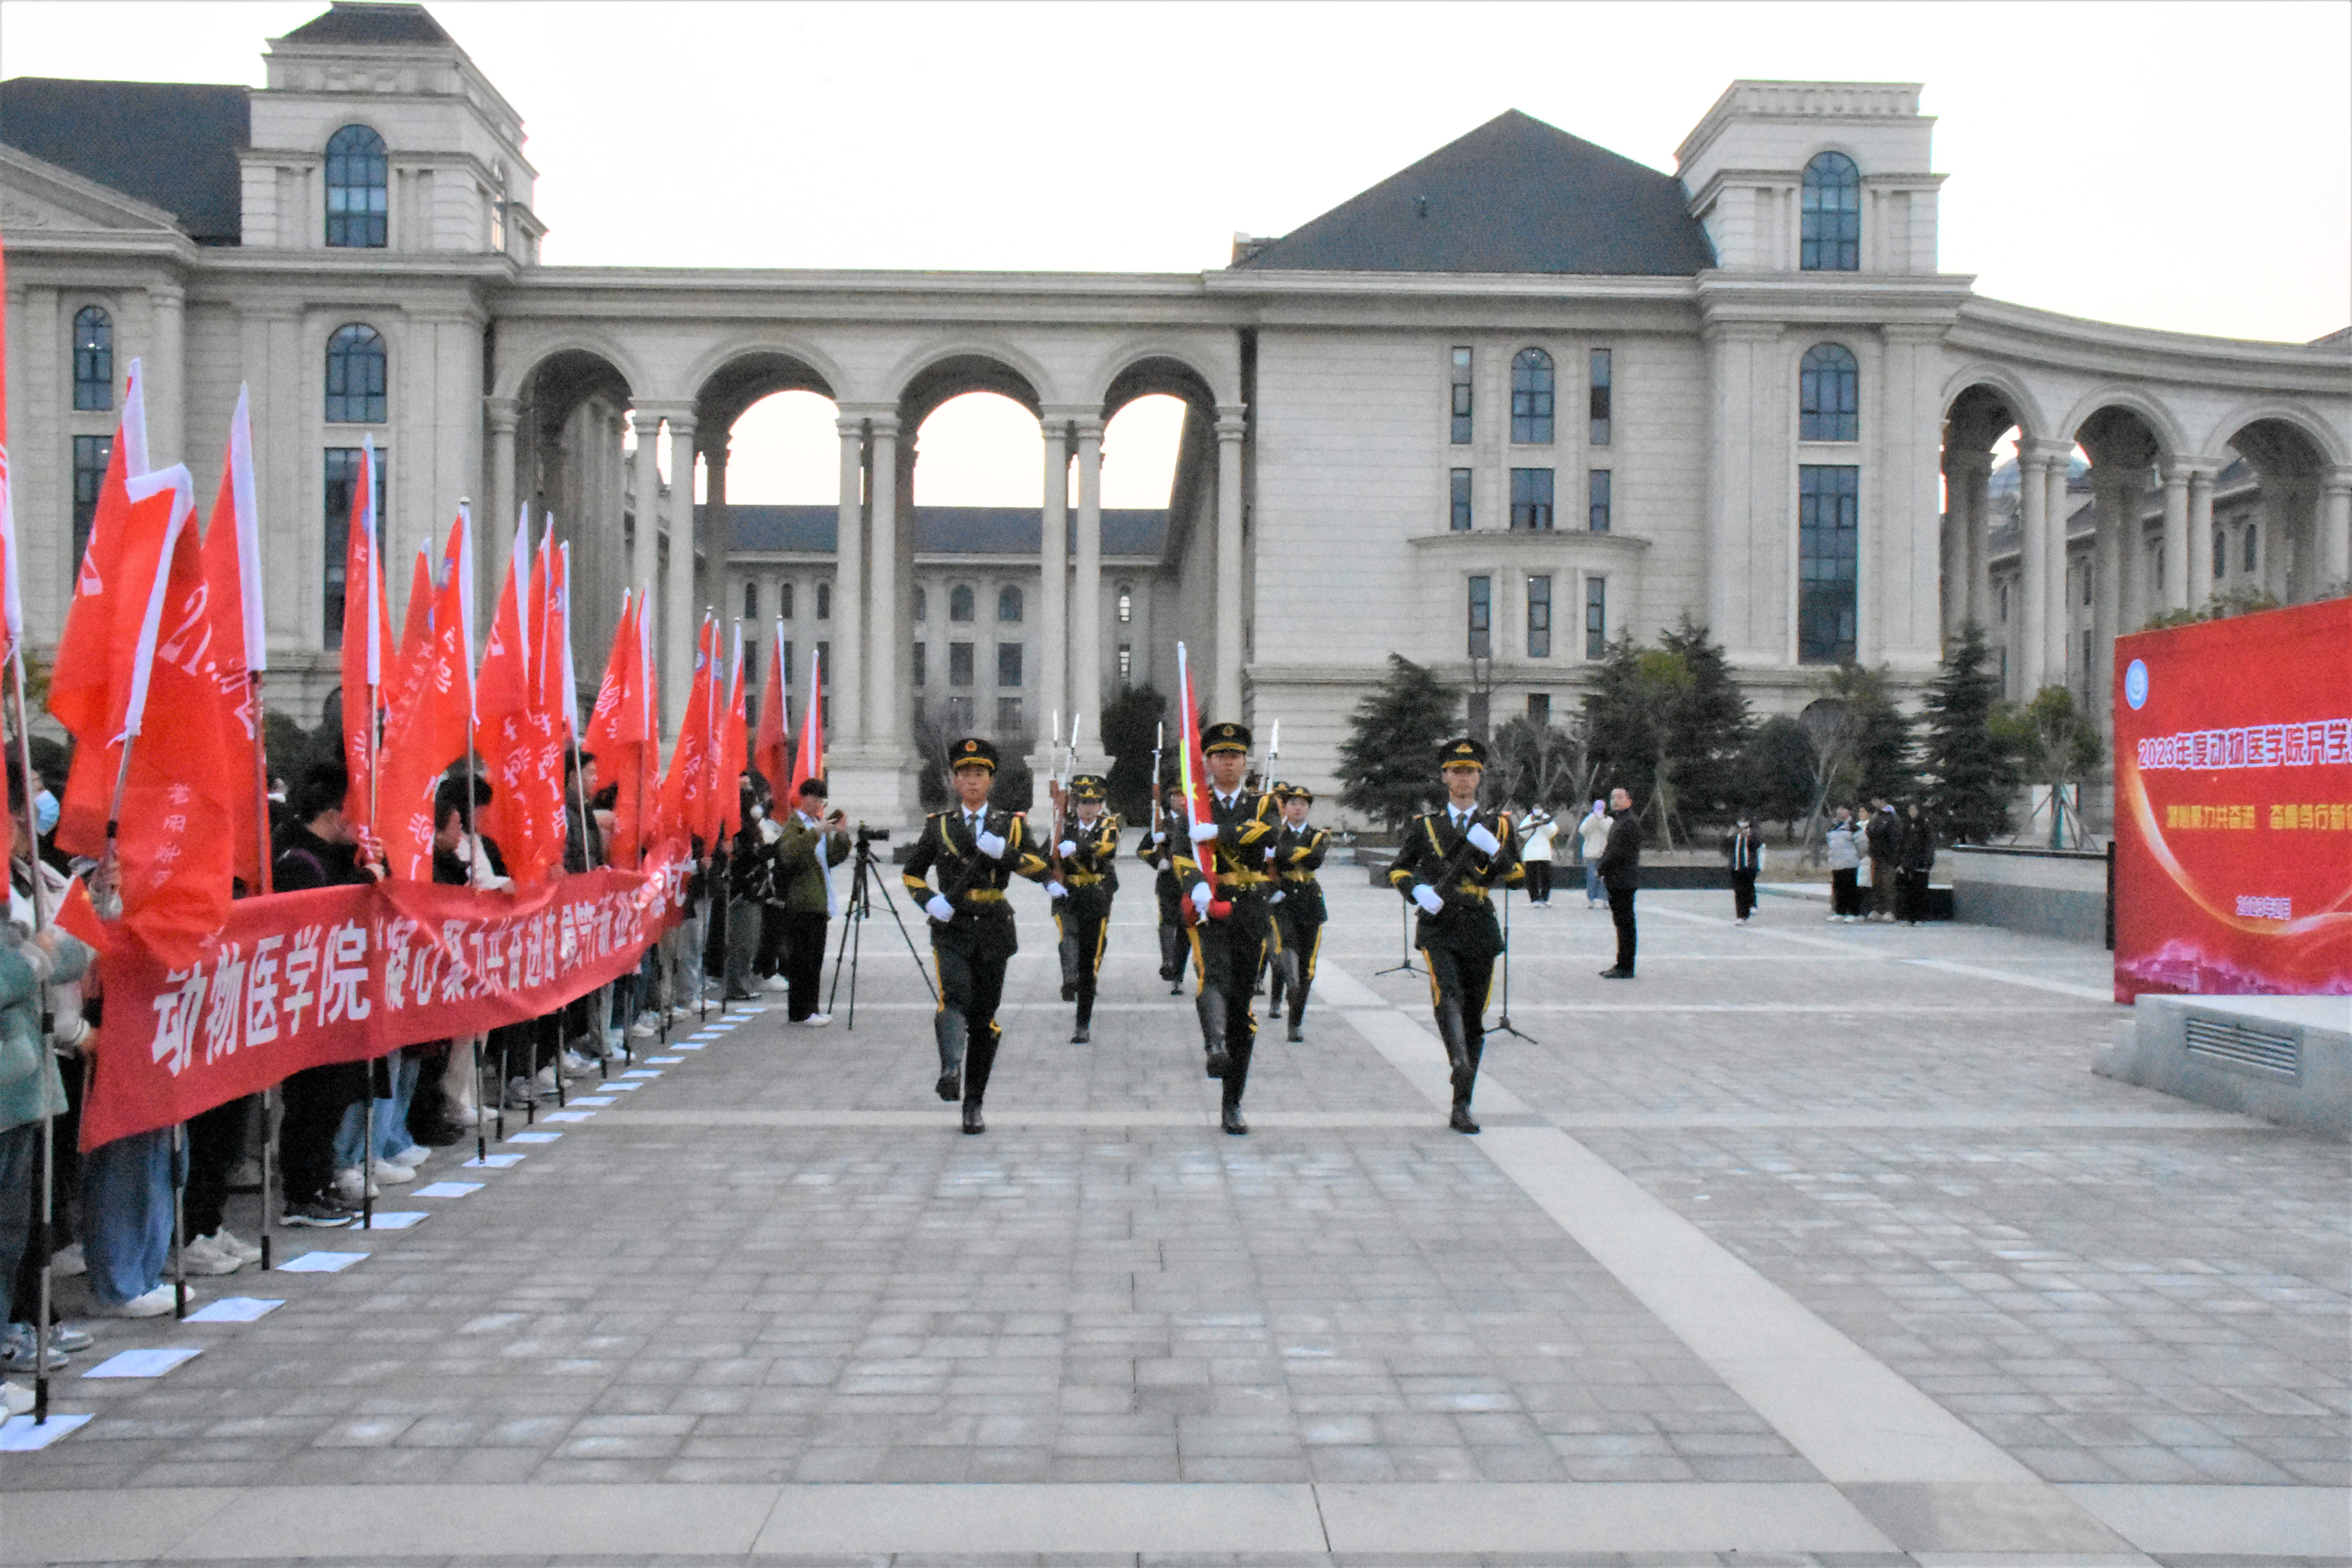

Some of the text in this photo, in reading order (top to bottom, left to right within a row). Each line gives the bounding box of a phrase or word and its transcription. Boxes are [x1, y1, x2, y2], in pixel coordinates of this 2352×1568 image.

[2138, 719, 2352, 770] 2023年度动物医学院开学
